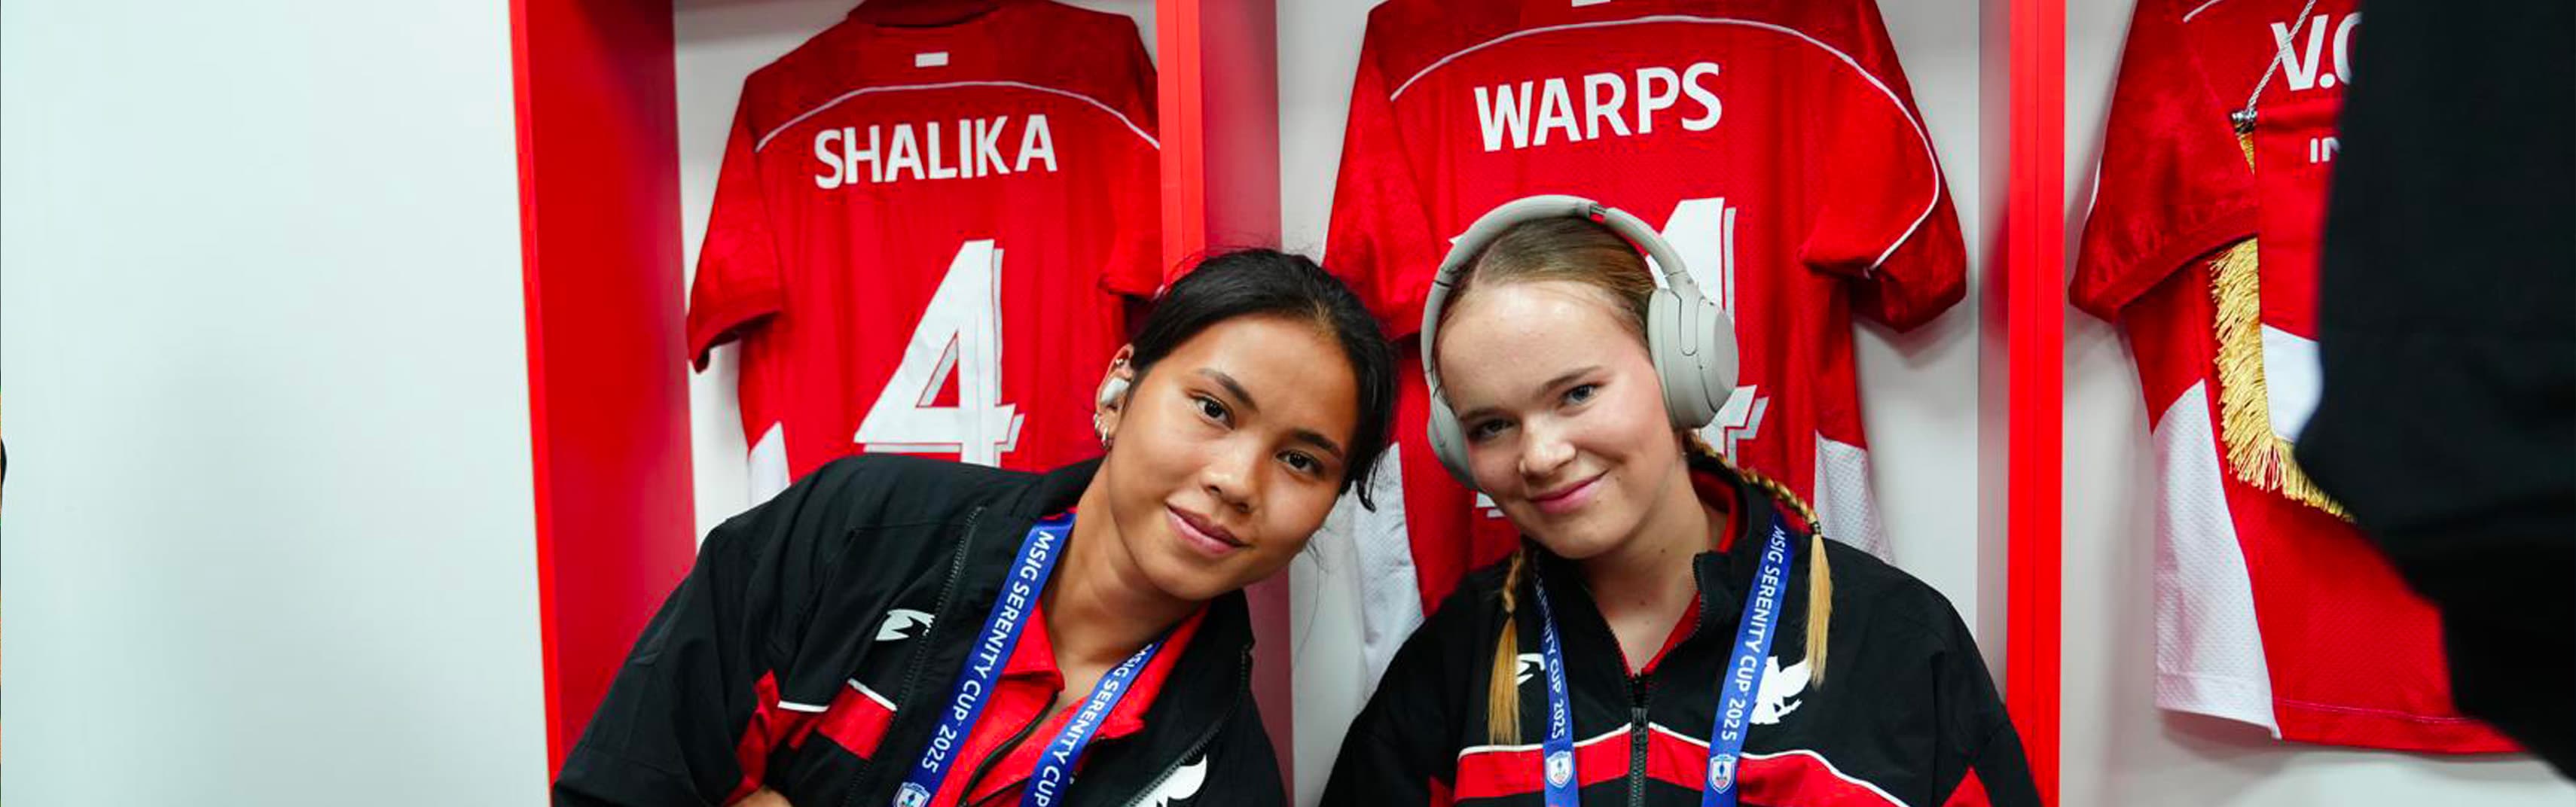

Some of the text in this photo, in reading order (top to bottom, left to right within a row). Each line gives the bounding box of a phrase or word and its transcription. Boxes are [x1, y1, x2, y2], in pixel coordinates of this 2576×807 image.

[1473, 62, 1723, 153] WARPS
[813, 114, 1058, 190] SHALIKA
[854, 239, 1026, 468] 4
[1020, 531, 1055, 581] MSIG
[1767, 525, 1787, 564] MSIG
[973, 581, 1030, 679] SERENITY
[1744, 565, 1781, 653] SERENITY
[922, 724, 957, 773] 2025
[1052, 679, 1119, 765] SERENITY
[1552, 699, 1566, 739] 2025
[1721, 698, 1747, 742] 2025
[1034, 766, 1061, 807] CUP
